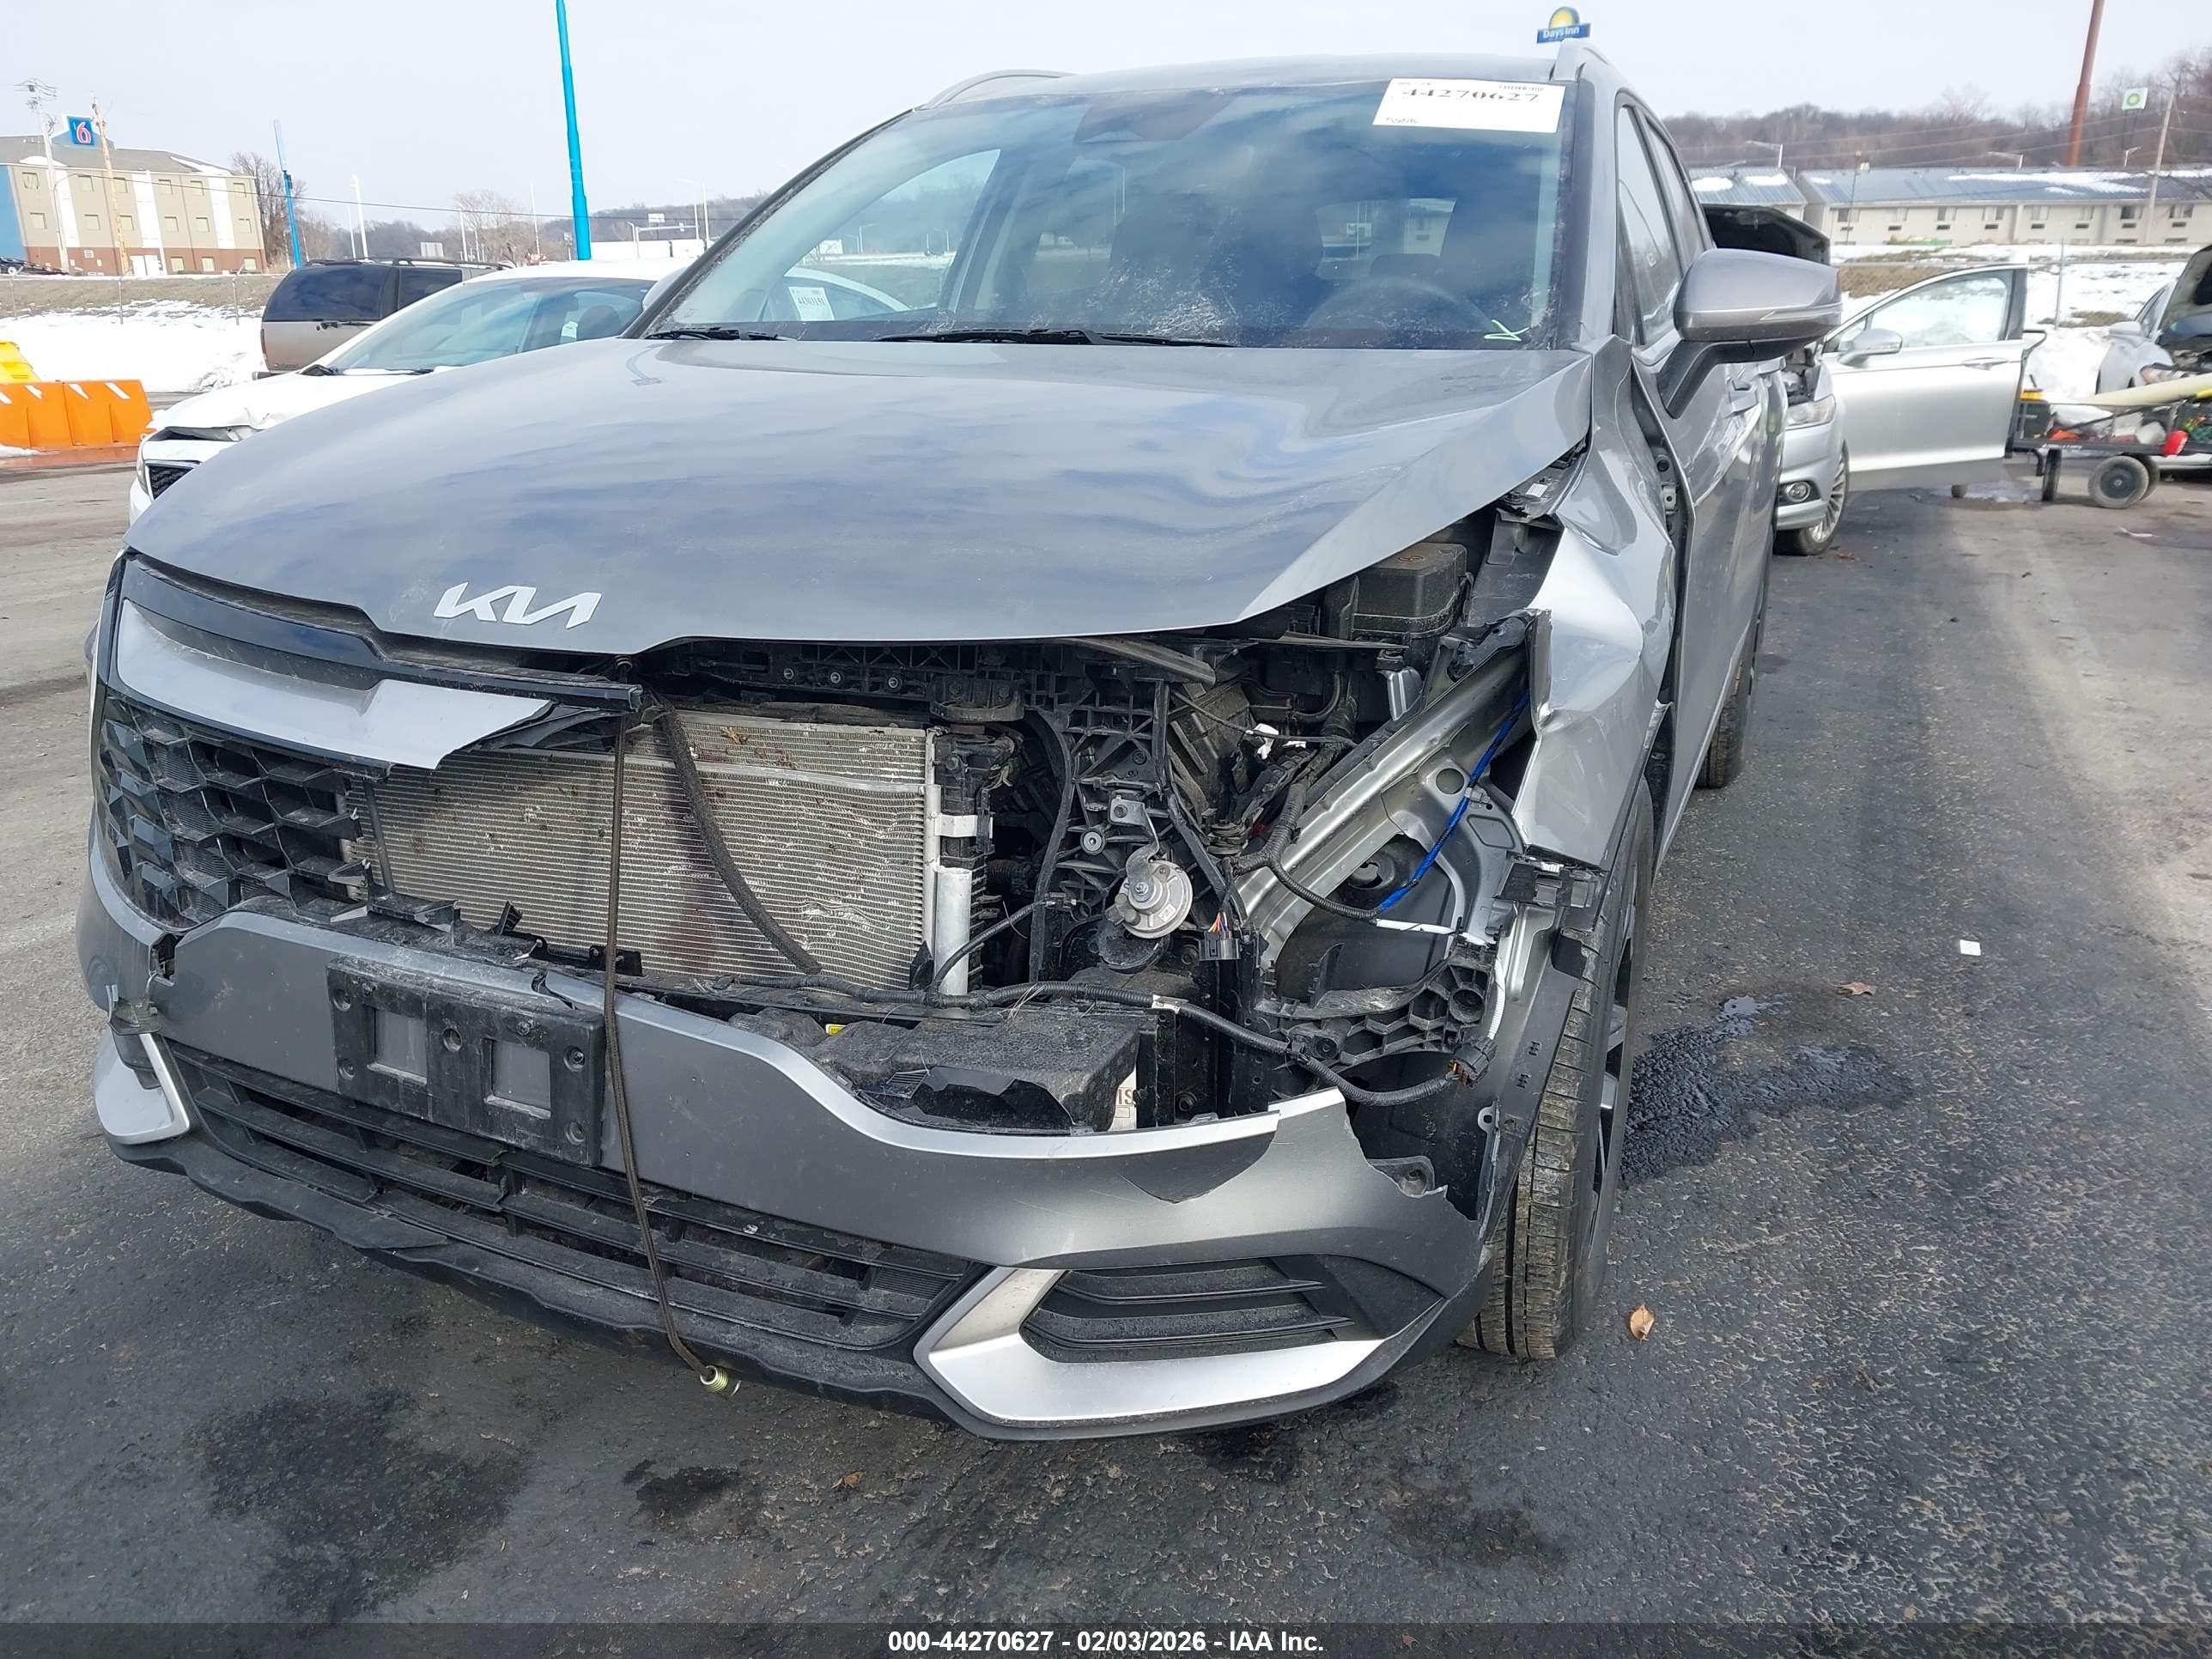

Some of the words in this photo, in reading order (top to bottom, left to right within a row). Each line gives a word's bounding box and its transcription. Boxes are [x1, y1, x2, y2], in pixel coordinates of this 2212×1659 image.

[1542, 29, 1564, 40] Days
[1565, 27, 1580, 36] Inn
[1401, 88, 1540, 102] 44270627
[76, 121, 92, 144] 6
[433, 581, 603, 630] KIA
